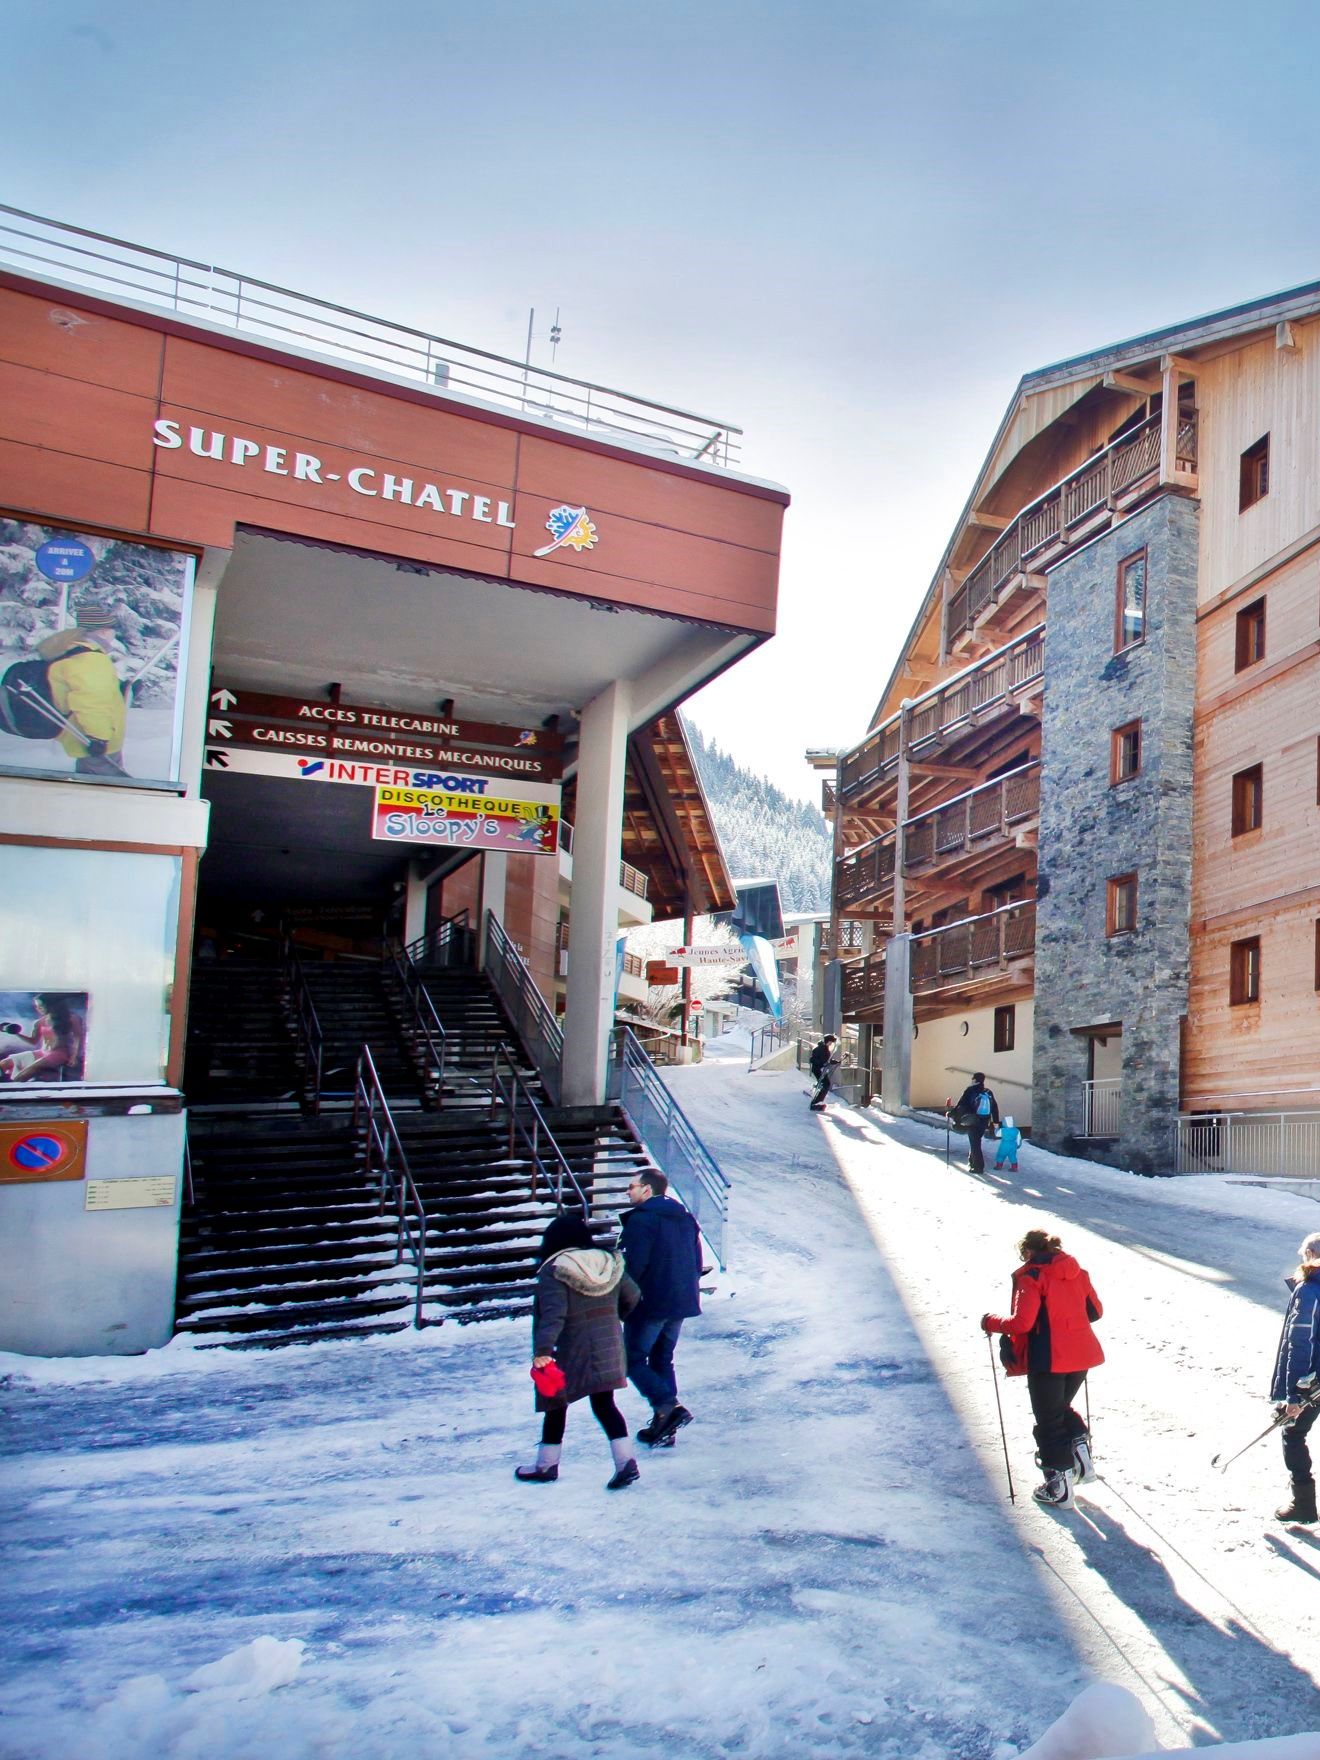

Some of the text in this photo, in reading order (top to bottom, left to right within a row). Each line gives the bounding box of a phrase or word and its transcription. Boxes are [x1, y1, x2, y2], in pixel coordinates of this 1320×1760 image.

[153, 419, 516, 528] SUPER-CHATEL
[48, 547, 85, 556] ARRIVEE
[299, 705, 460, 736] ACCES TELECABINE
[252, 728, 542, 772] CAISSES REMONTEES MECANIQUES
[382, 790, 521, 815] DISCOTHEQUE
[422, 802, 448, 818] Le
[385, 812, 500, 843] Sloopy's
